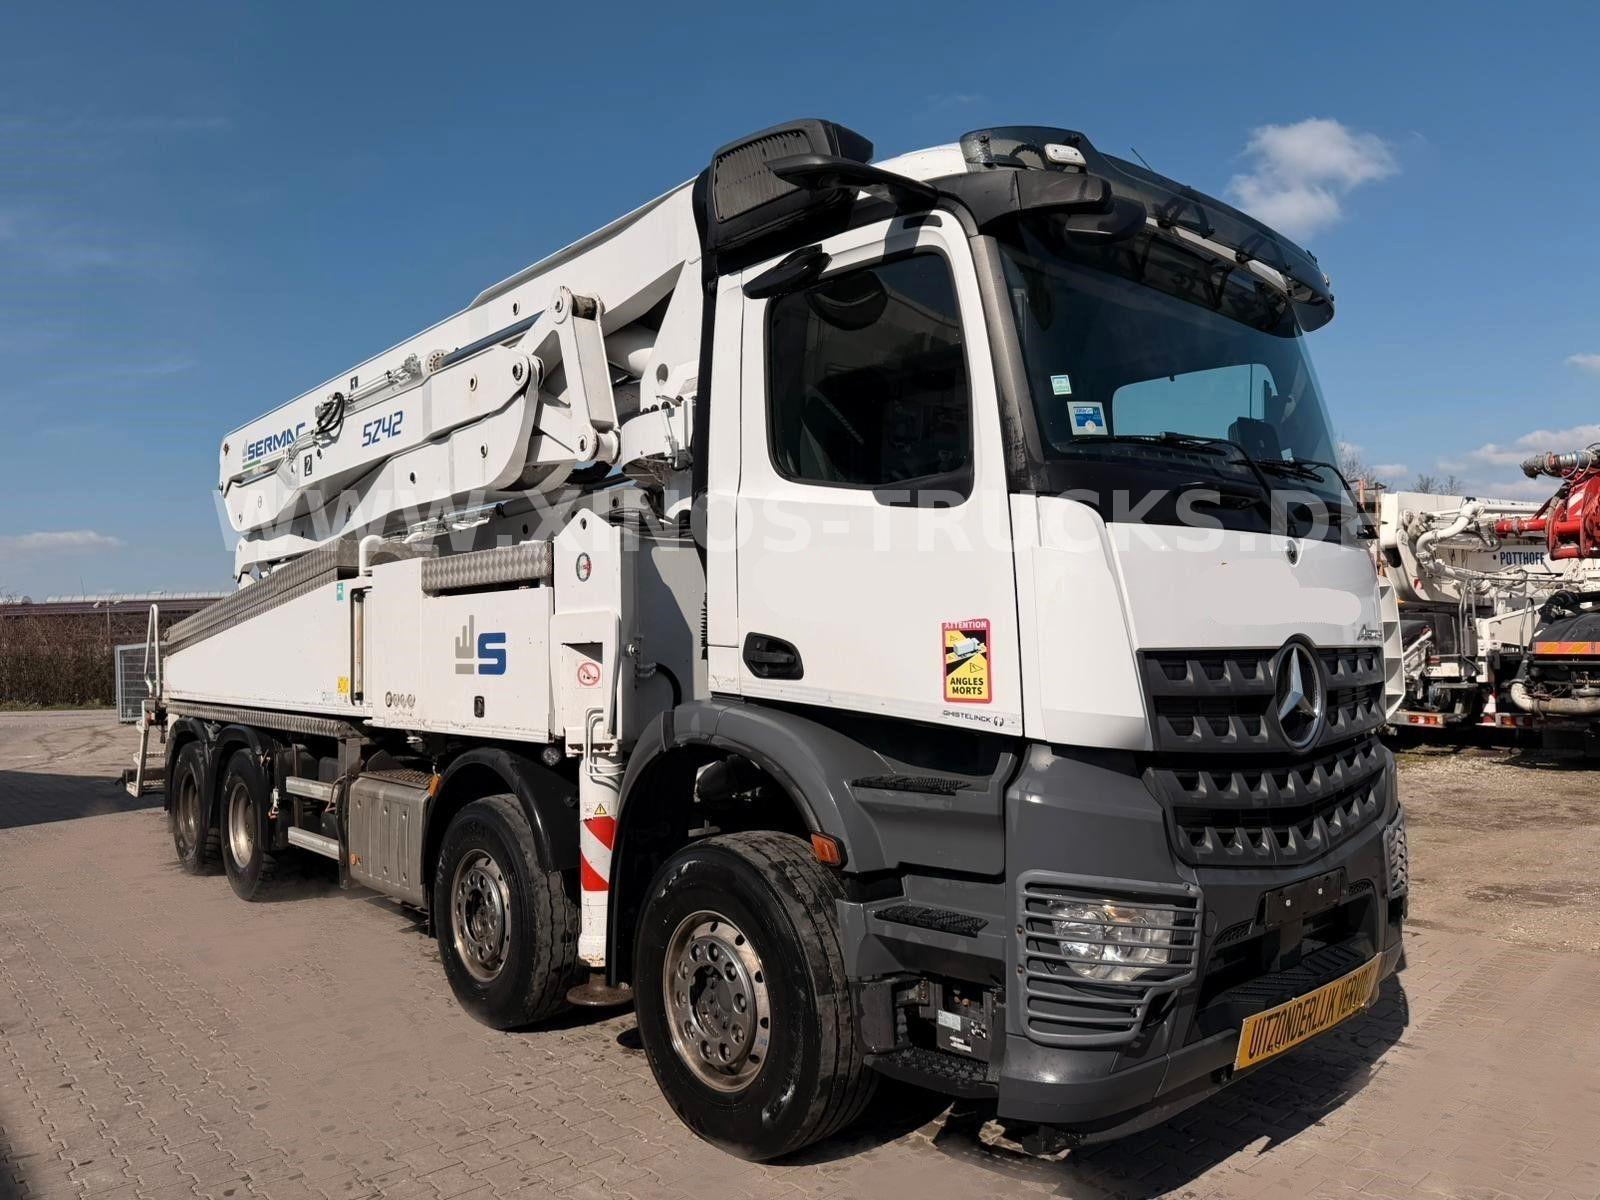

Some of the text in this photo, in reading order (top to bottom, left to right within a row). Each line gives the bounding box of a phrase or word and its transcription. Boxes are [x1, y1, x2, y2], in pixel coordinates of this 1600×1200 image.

[1500, 552, 1545, 566] POTTHOFF
[944, 620, 987, 630] ATTENTION
[950, 677, 984, 686] ANGLES
[952, 686, 983, 695] MORTS
[1249, 985, 1340, 1059] UITZONDERLIJK
